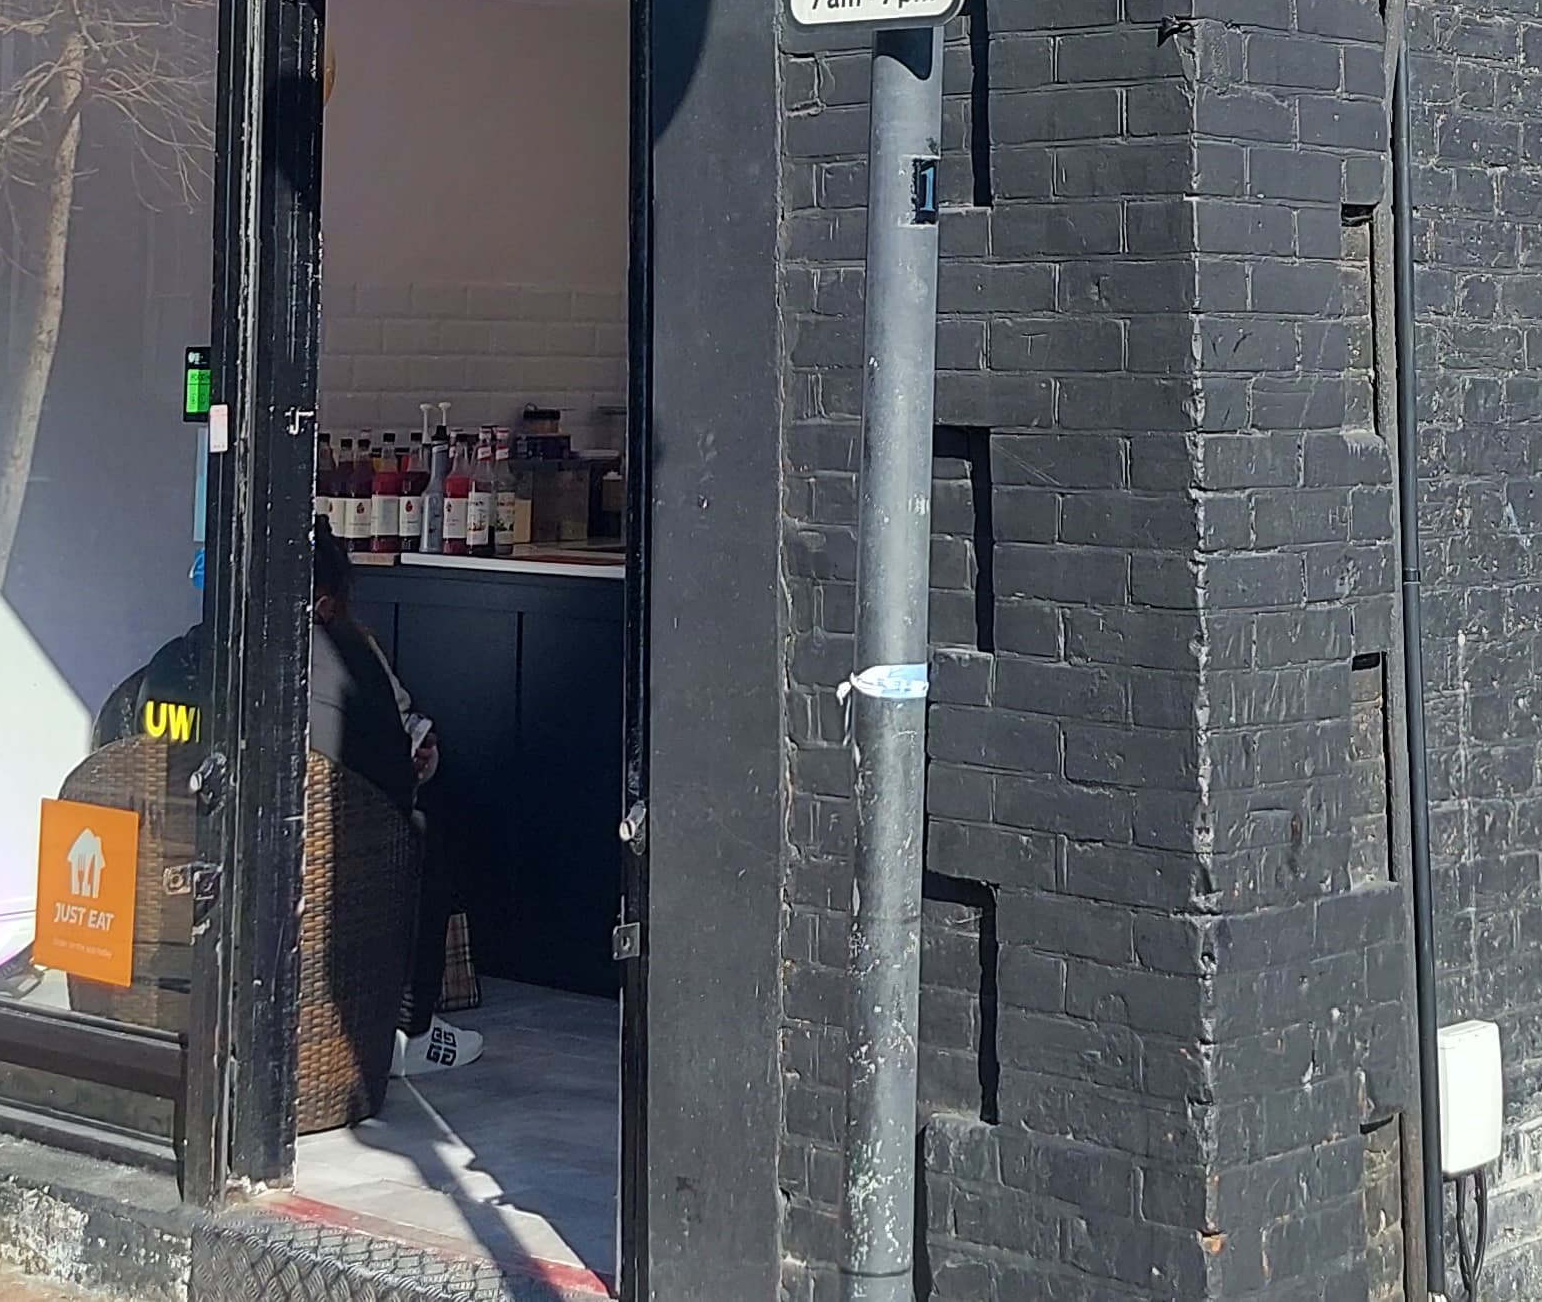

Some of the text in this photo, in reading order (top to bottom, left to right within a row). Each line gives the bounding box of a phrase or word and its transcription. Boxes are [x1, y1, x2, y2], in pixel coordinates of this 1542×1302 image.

[146, 700, 201, 743] UW
[54, 902, 115, 931] JUST EAT
